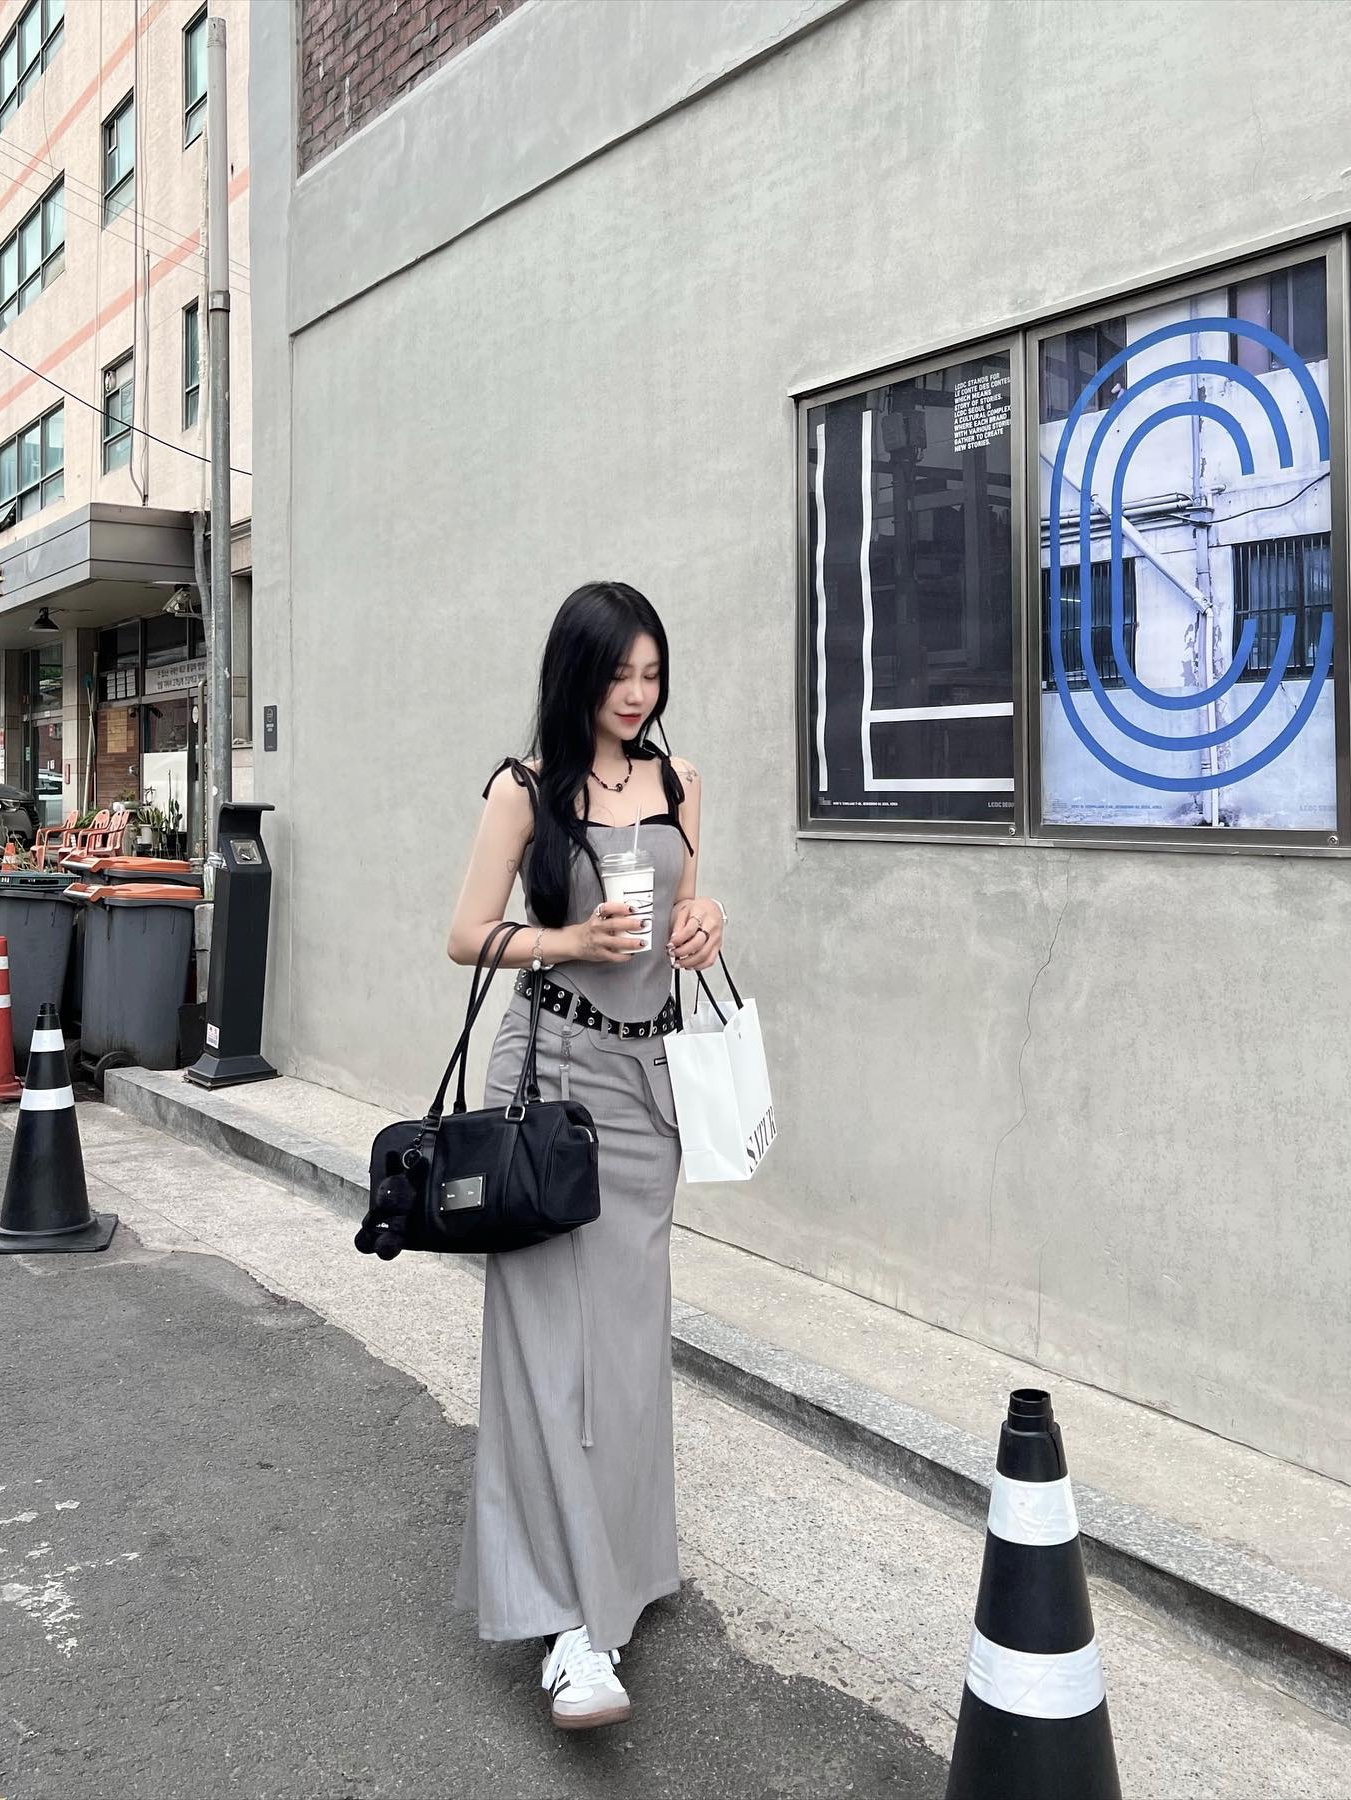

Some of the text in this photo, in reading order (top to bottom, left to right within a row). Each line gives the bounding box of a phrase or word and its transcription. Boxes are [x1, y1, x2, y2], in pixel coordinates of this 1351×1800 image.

[967, 376, 989, 386] STANDS
[990, 373, 1000, 381] FOR
[954, 389, 992, 404] WHICH MEANS
[961, 385, 978, 396] CONTE
[979, 383, 990, 391] DES
[954, 401, 971, 411] STORY
[968, 405, 985, 415] SEOUL
[959, 411, 986, 424] CULTURAL
[987, 405, 1011, 417] COMPLEX
[954, 413, 1008, 432] WHERE EACH BRAND
[954, 419, 1011, 439] WITH VARIOUS STORIE
[954, 435, 975, 446] GATHER
[984, 427, 1004, 439] CREATE
[955, 444, 967, 452] NEW
